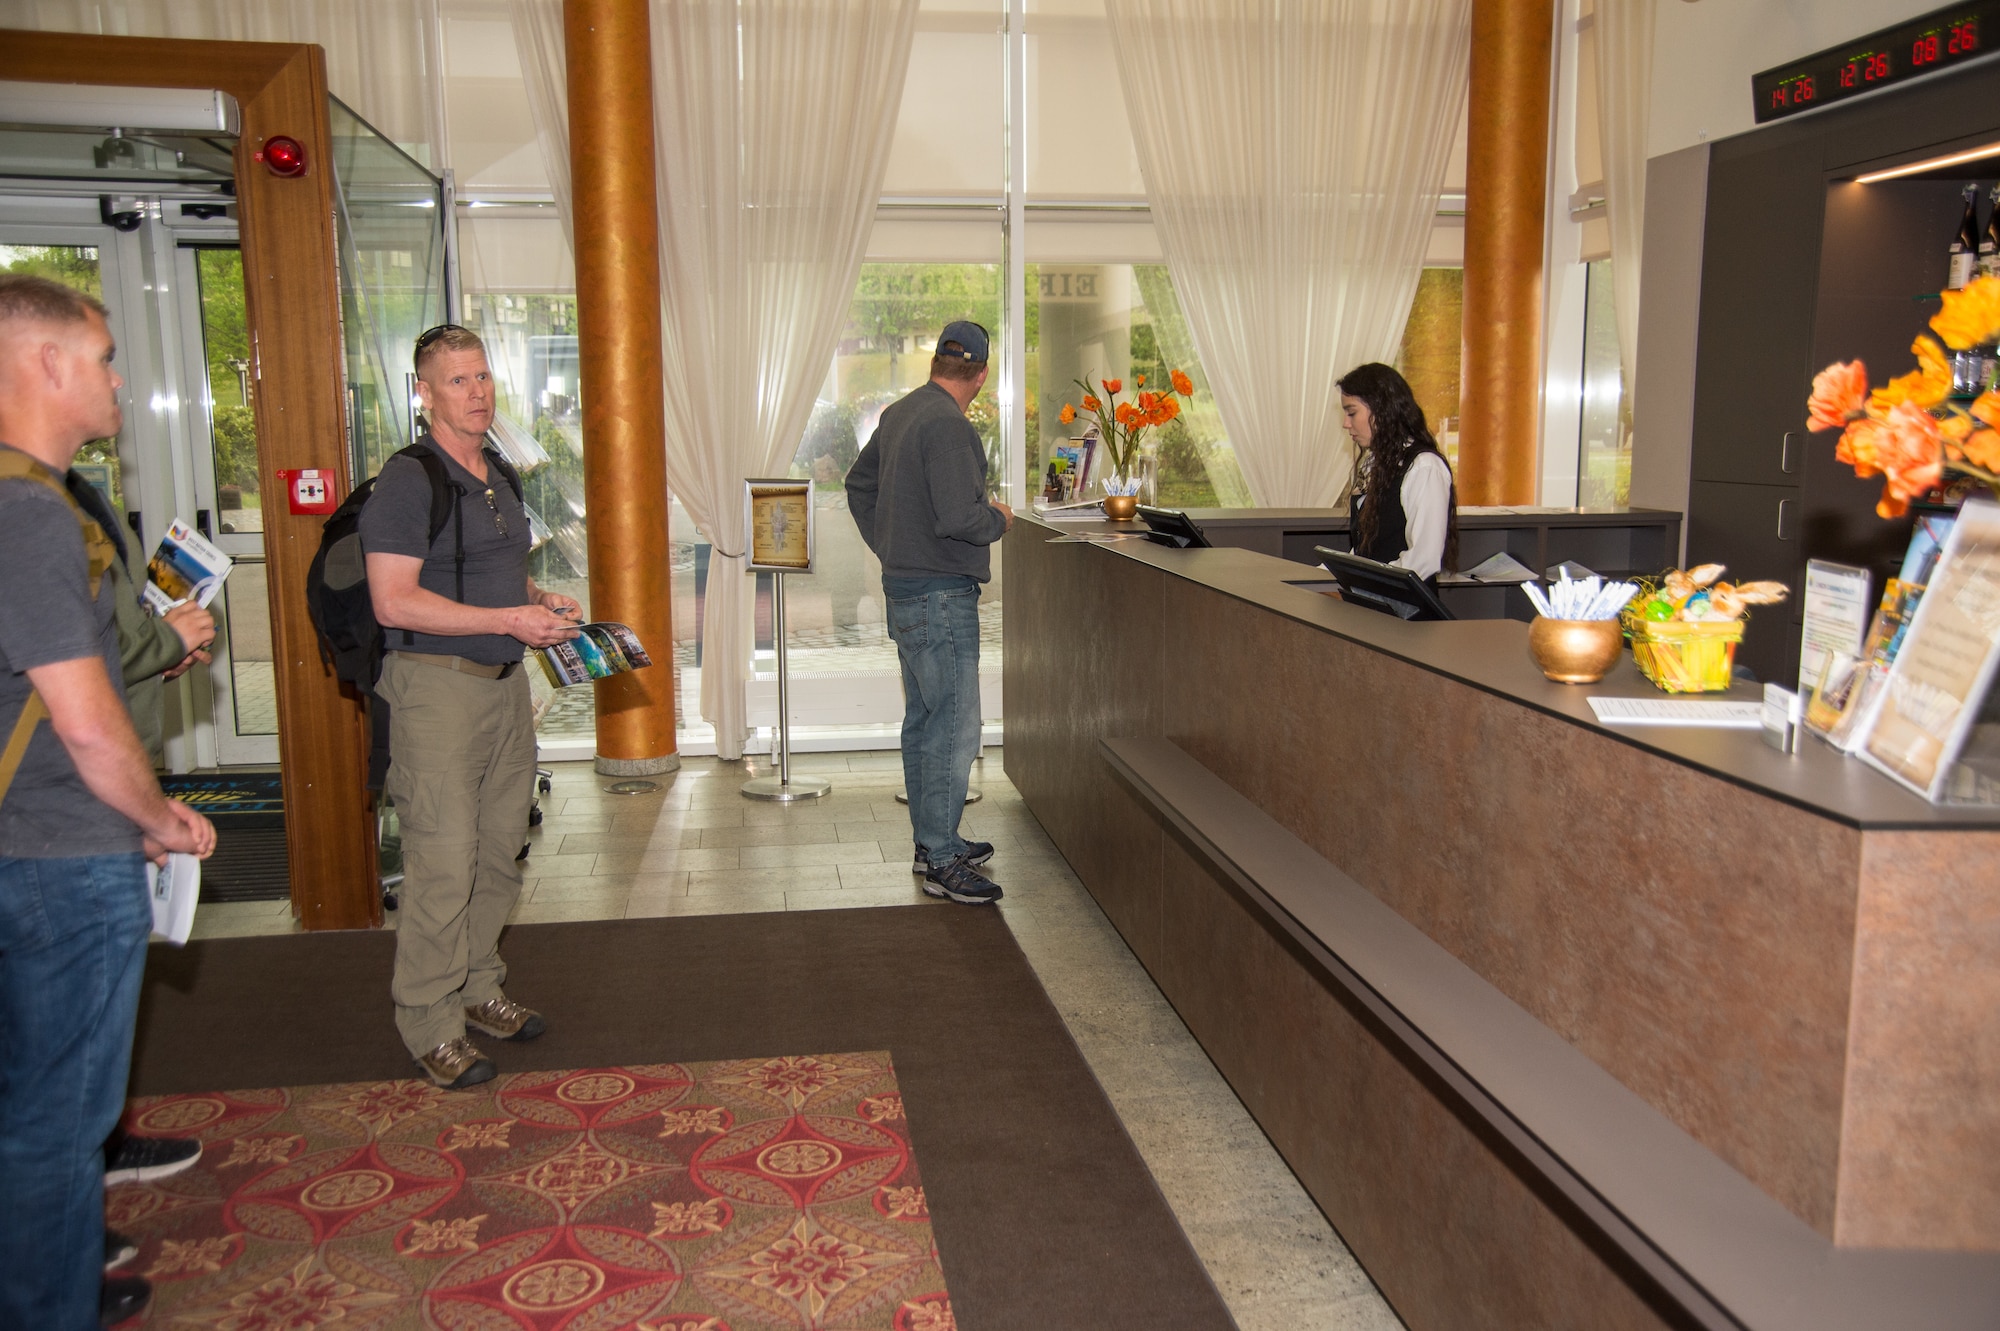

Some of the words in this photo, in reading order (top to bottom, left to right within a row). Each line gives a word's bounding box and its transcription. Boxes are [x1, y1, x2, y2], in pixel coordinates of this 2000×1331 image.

[1771, 88, 1785, 109] 14
[1794, 78, 1813, 103] 26
[1840, 63, 1855, 87] 12
[1865, 53, 1887, 81] 26
[1912, 35, 1937, 66] 08
[1948, 23, 1975, 54] 26
